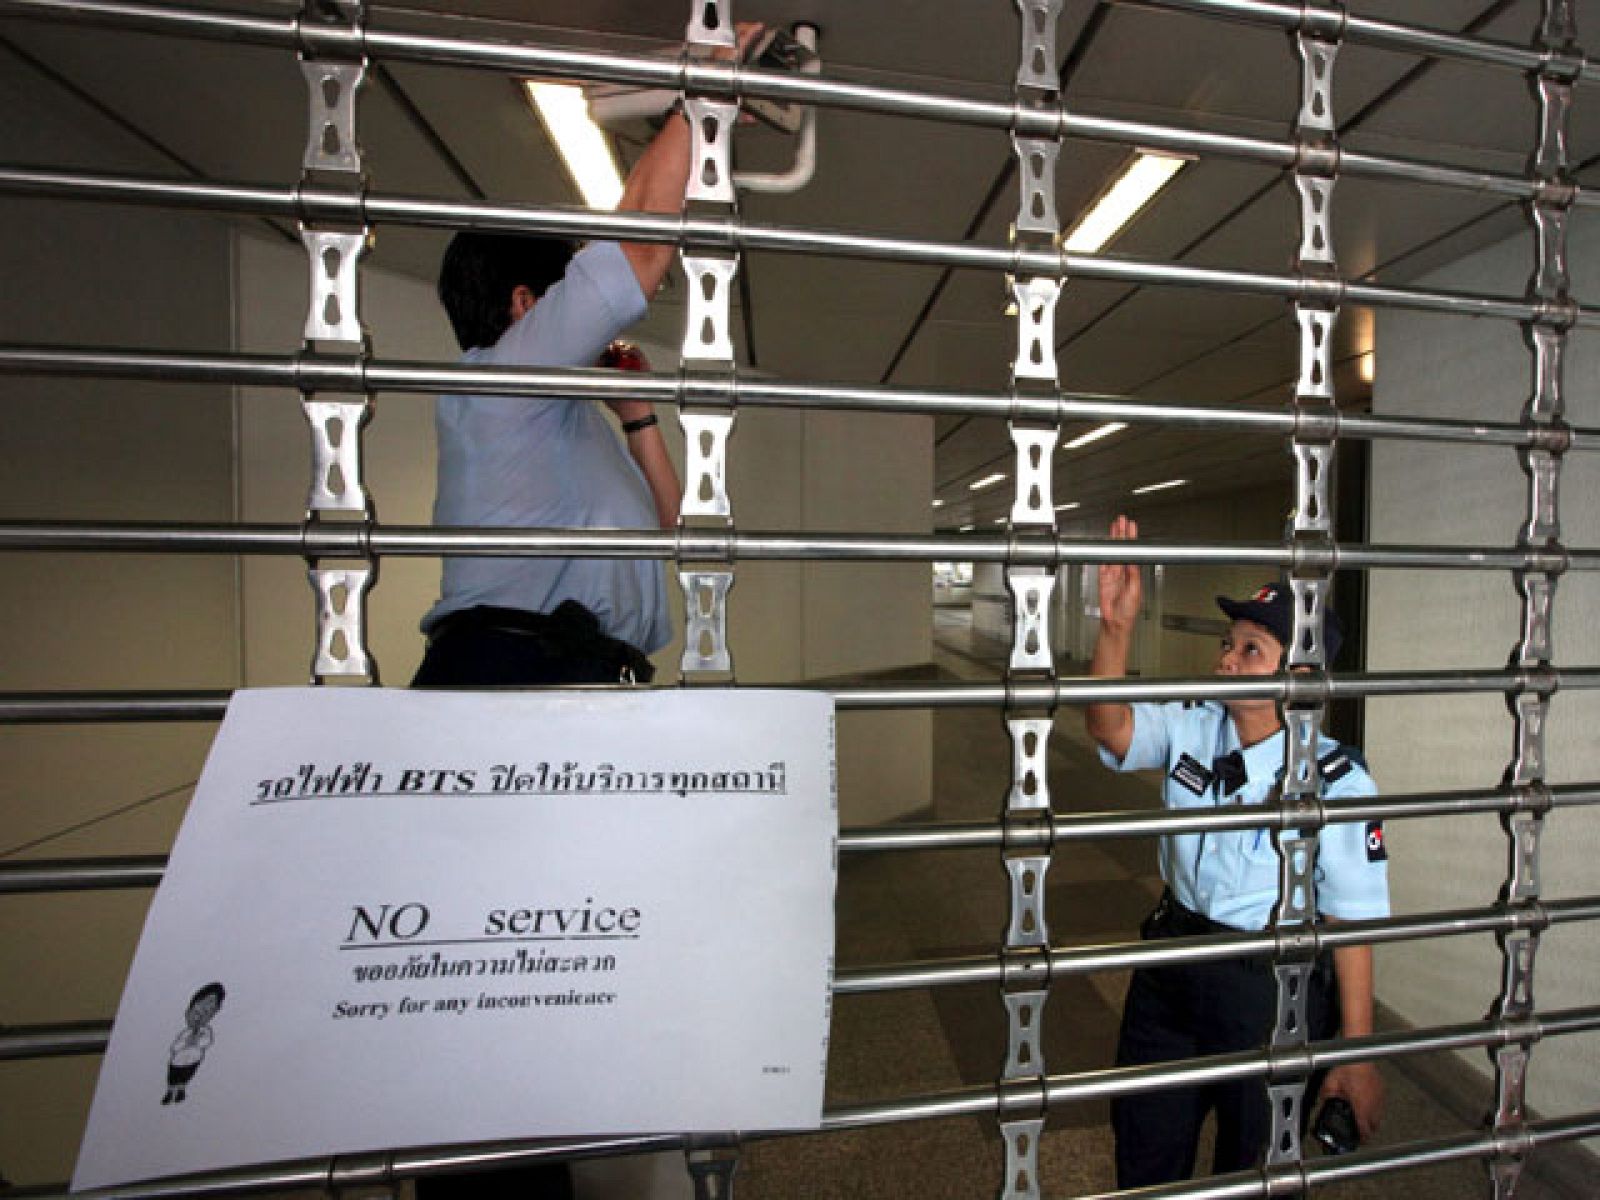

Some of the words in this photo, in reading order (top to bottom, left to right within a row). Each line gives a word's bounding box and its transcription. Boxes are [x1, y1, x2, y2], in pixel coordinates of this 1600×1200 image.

[399, 769, 478, 792] BTS
[345, 902, 430, 941] NO
[485, 898, 641, 935] service
[333, 1000, 389, 1020] Sorry
[398, 997, 429, 1015] for
[433, 997, 468, 1015] any
